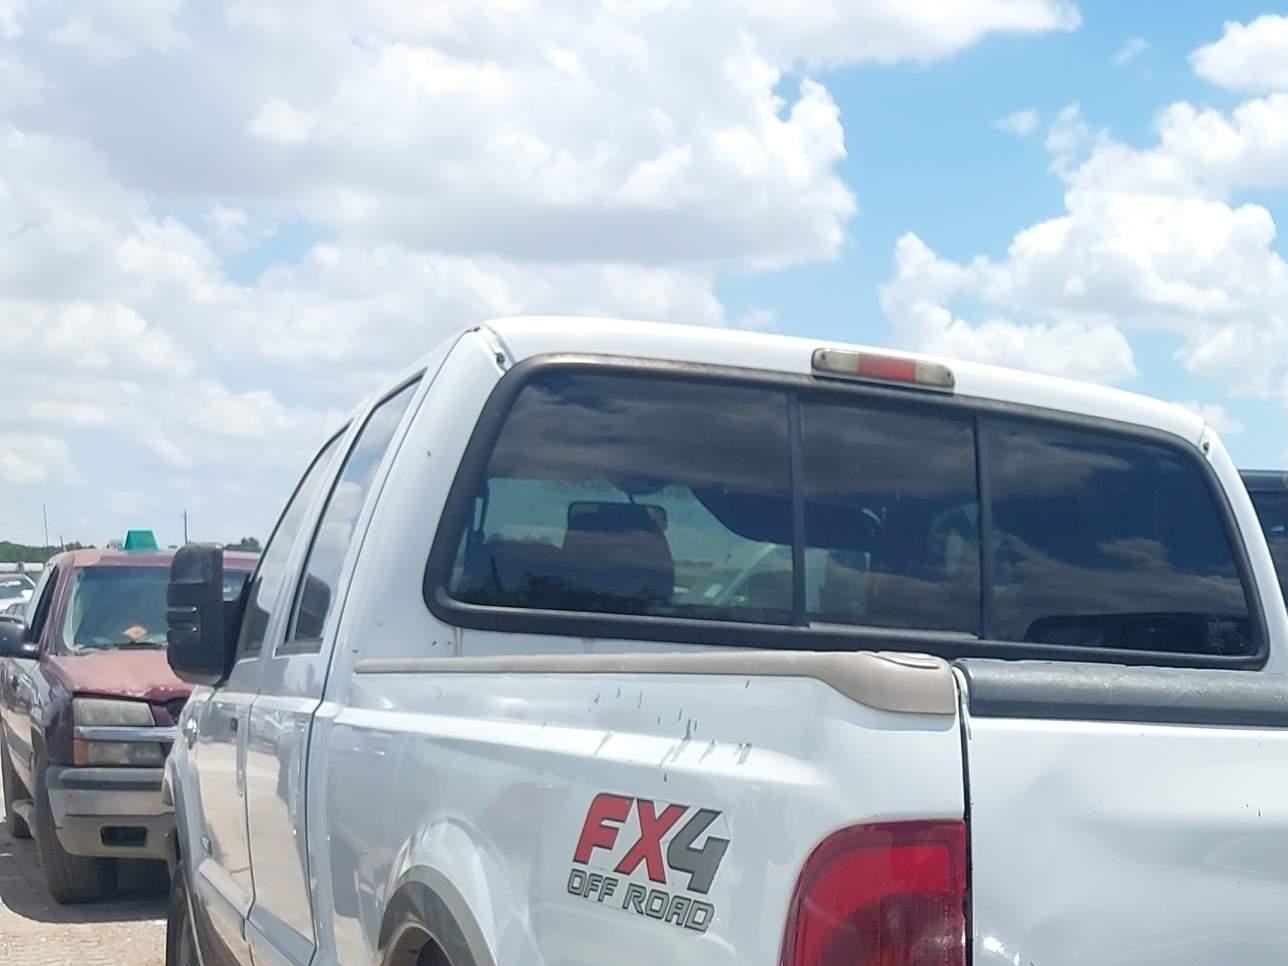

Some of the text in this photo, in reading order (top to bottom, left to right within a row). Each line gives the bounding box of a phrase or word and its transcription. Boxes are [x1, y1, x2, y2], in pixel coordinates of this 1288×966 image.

[573, 792, 732, 895] FX4
[567, 868, 715, 933] OFF ROAD
